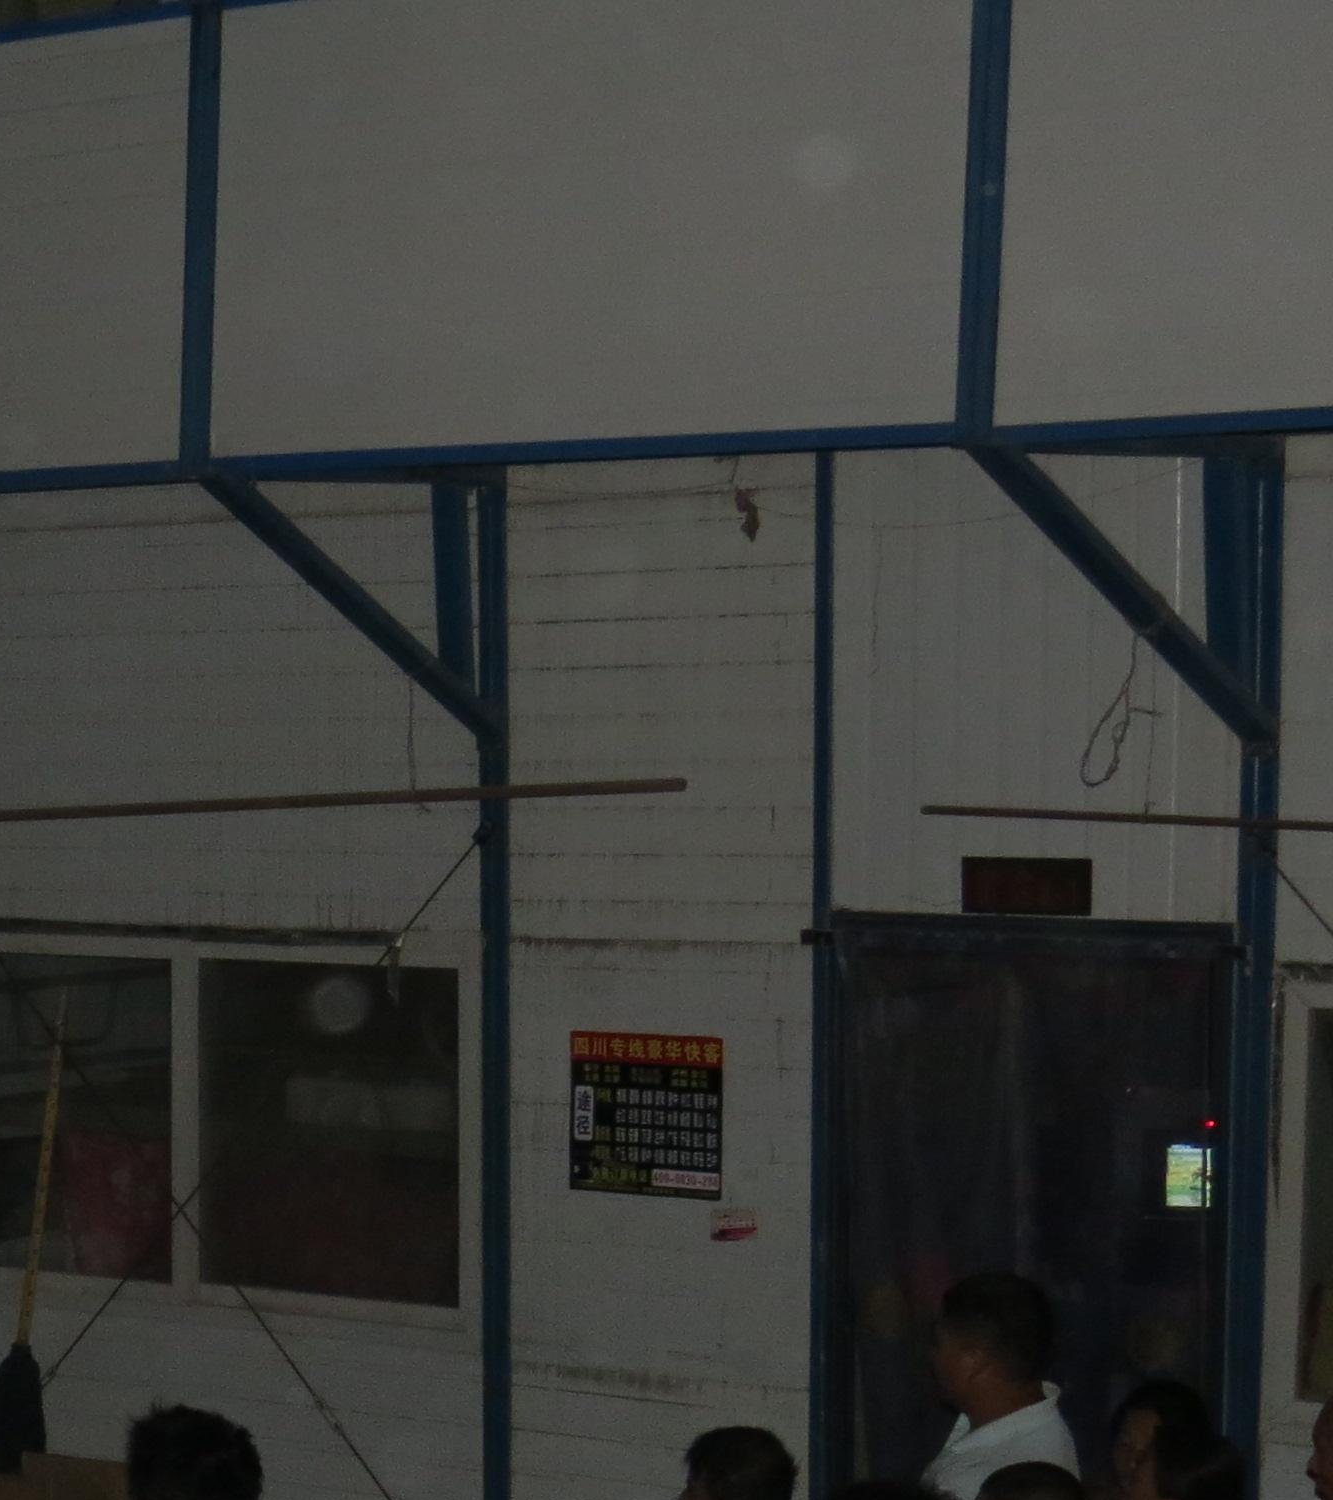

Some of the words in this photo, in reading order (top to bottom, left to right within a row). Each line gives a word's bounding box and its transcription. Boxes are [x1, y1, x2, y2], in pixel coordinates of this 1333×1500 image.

[573, 1037, 721, 1063] 四川专线豪华快客
[577, 1090, 592, 1135] 途径
